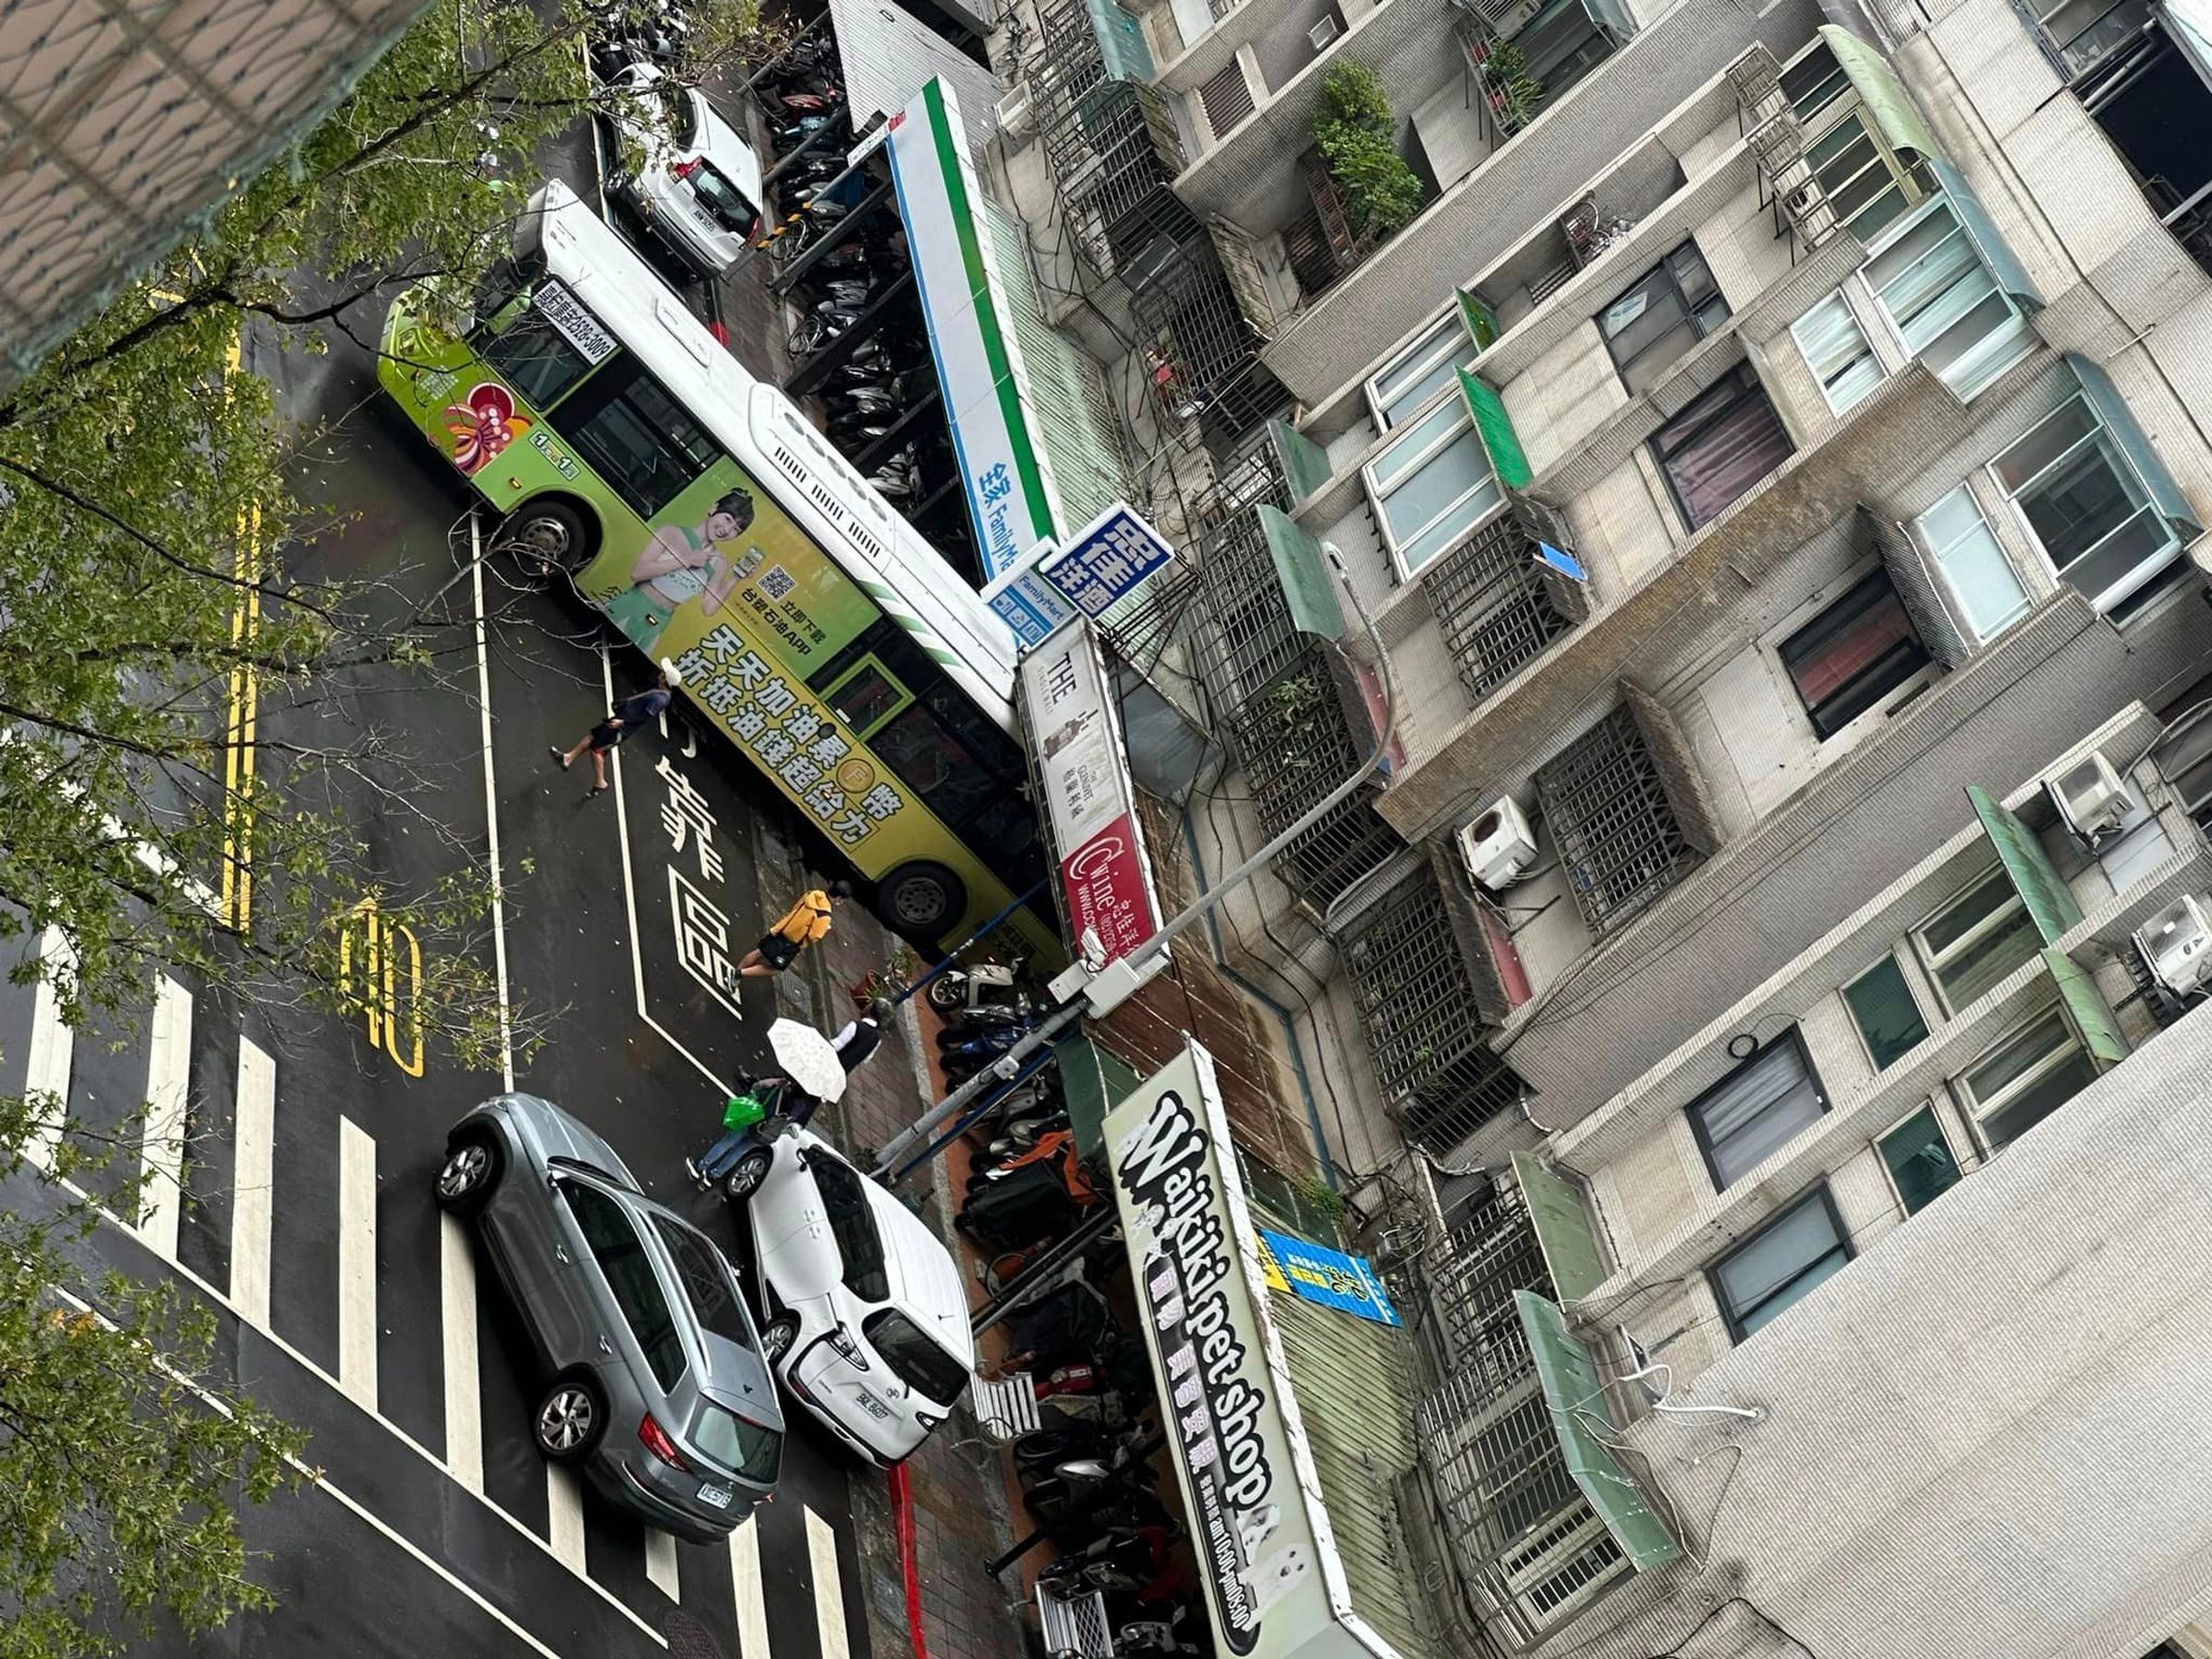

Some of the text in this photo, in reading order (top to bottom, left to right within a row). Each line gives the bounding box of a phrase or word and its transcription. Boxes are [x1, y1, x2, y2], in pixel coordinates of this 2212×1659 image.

[979, 462, 1012, 508] 全家
[988, 503, 1020, 572] FamilyMa
[1018, 575, 1065, 621] FamilyMart
[1050, 557, 1114, 616] 洋酒
[780, 600, 827, 644] 立即下載
[1047, 651, 1077, 704] THE
[1122, 1094, 1268, 1505] Waikiki pet shop
